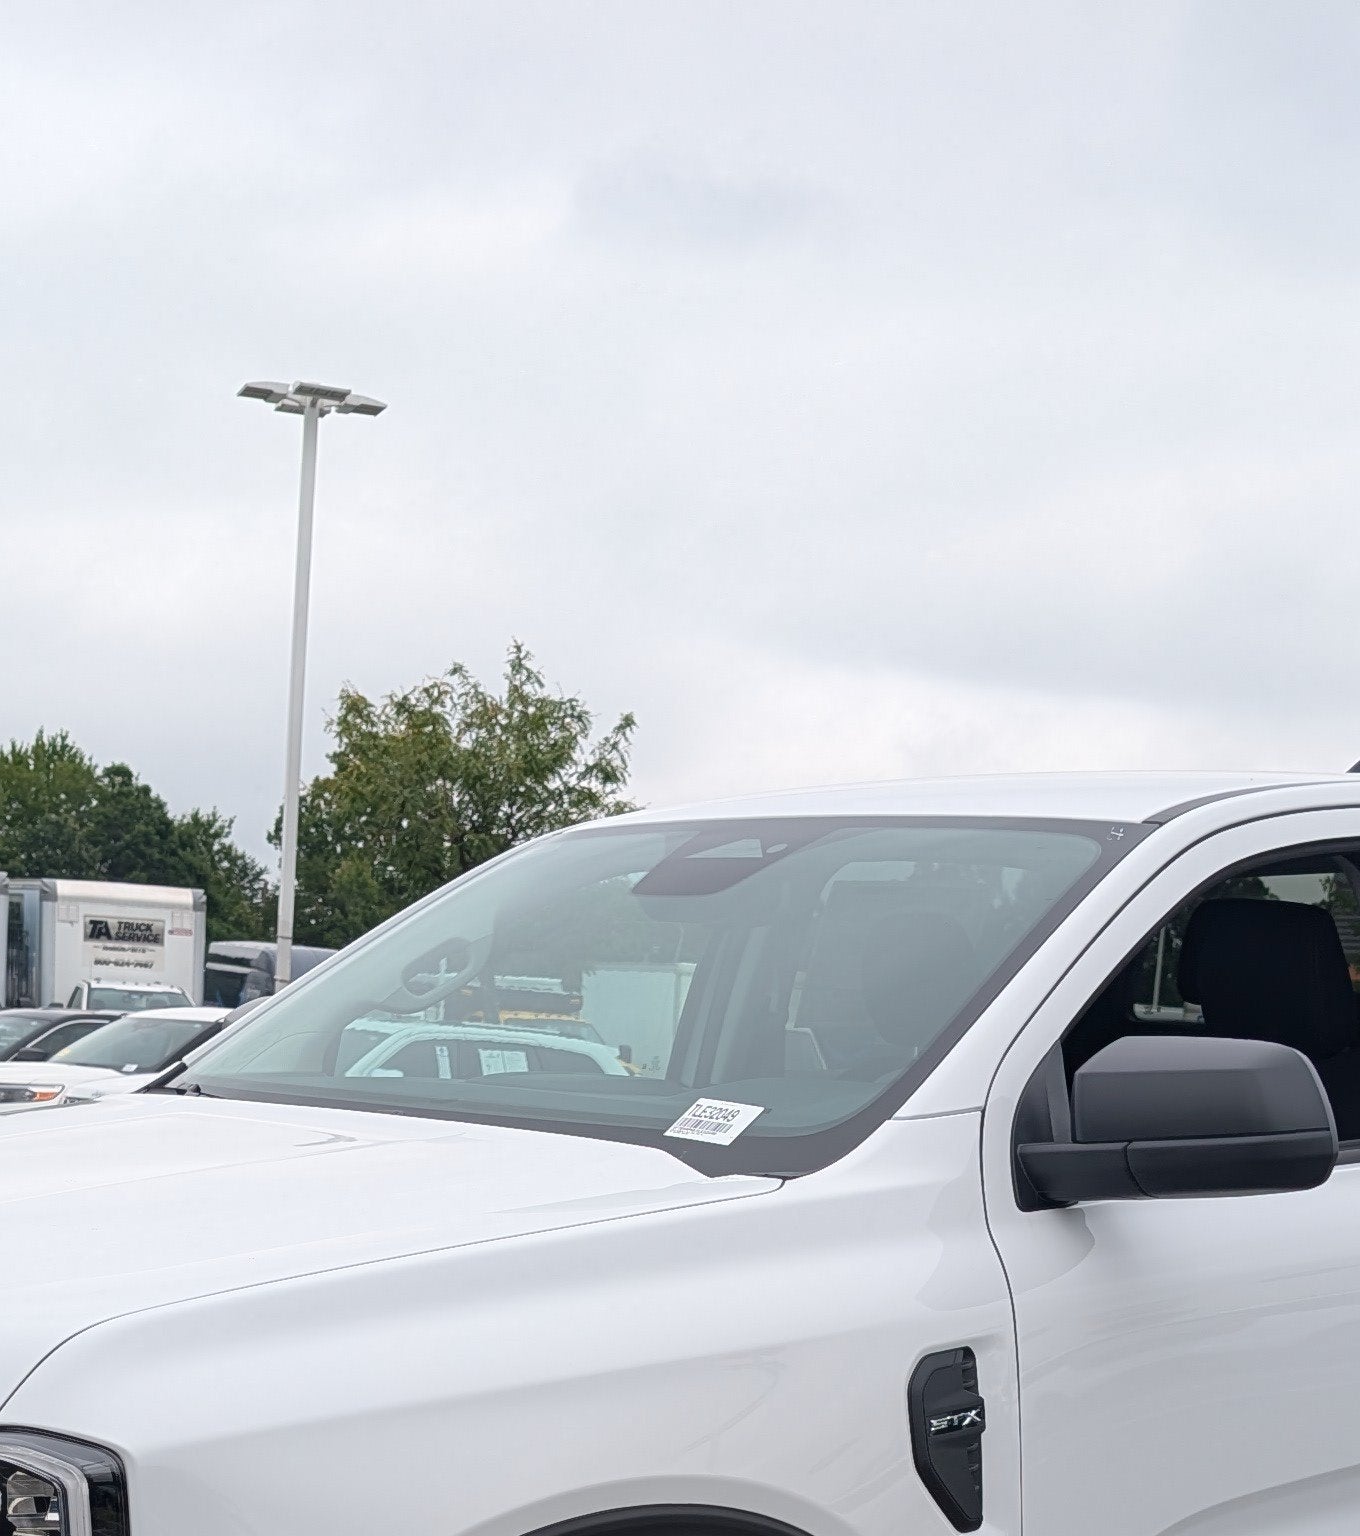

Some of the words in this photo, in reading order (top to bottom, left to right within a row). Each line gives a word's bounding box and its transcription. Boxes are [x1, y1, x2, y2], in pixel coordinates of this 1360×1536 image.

[89, 919, 112, 940] TA
[117, 921, 154, 932] TRUCK
[115, 931, 161, 943] SERVICE
[930, 1408, 982, 1432] STX
